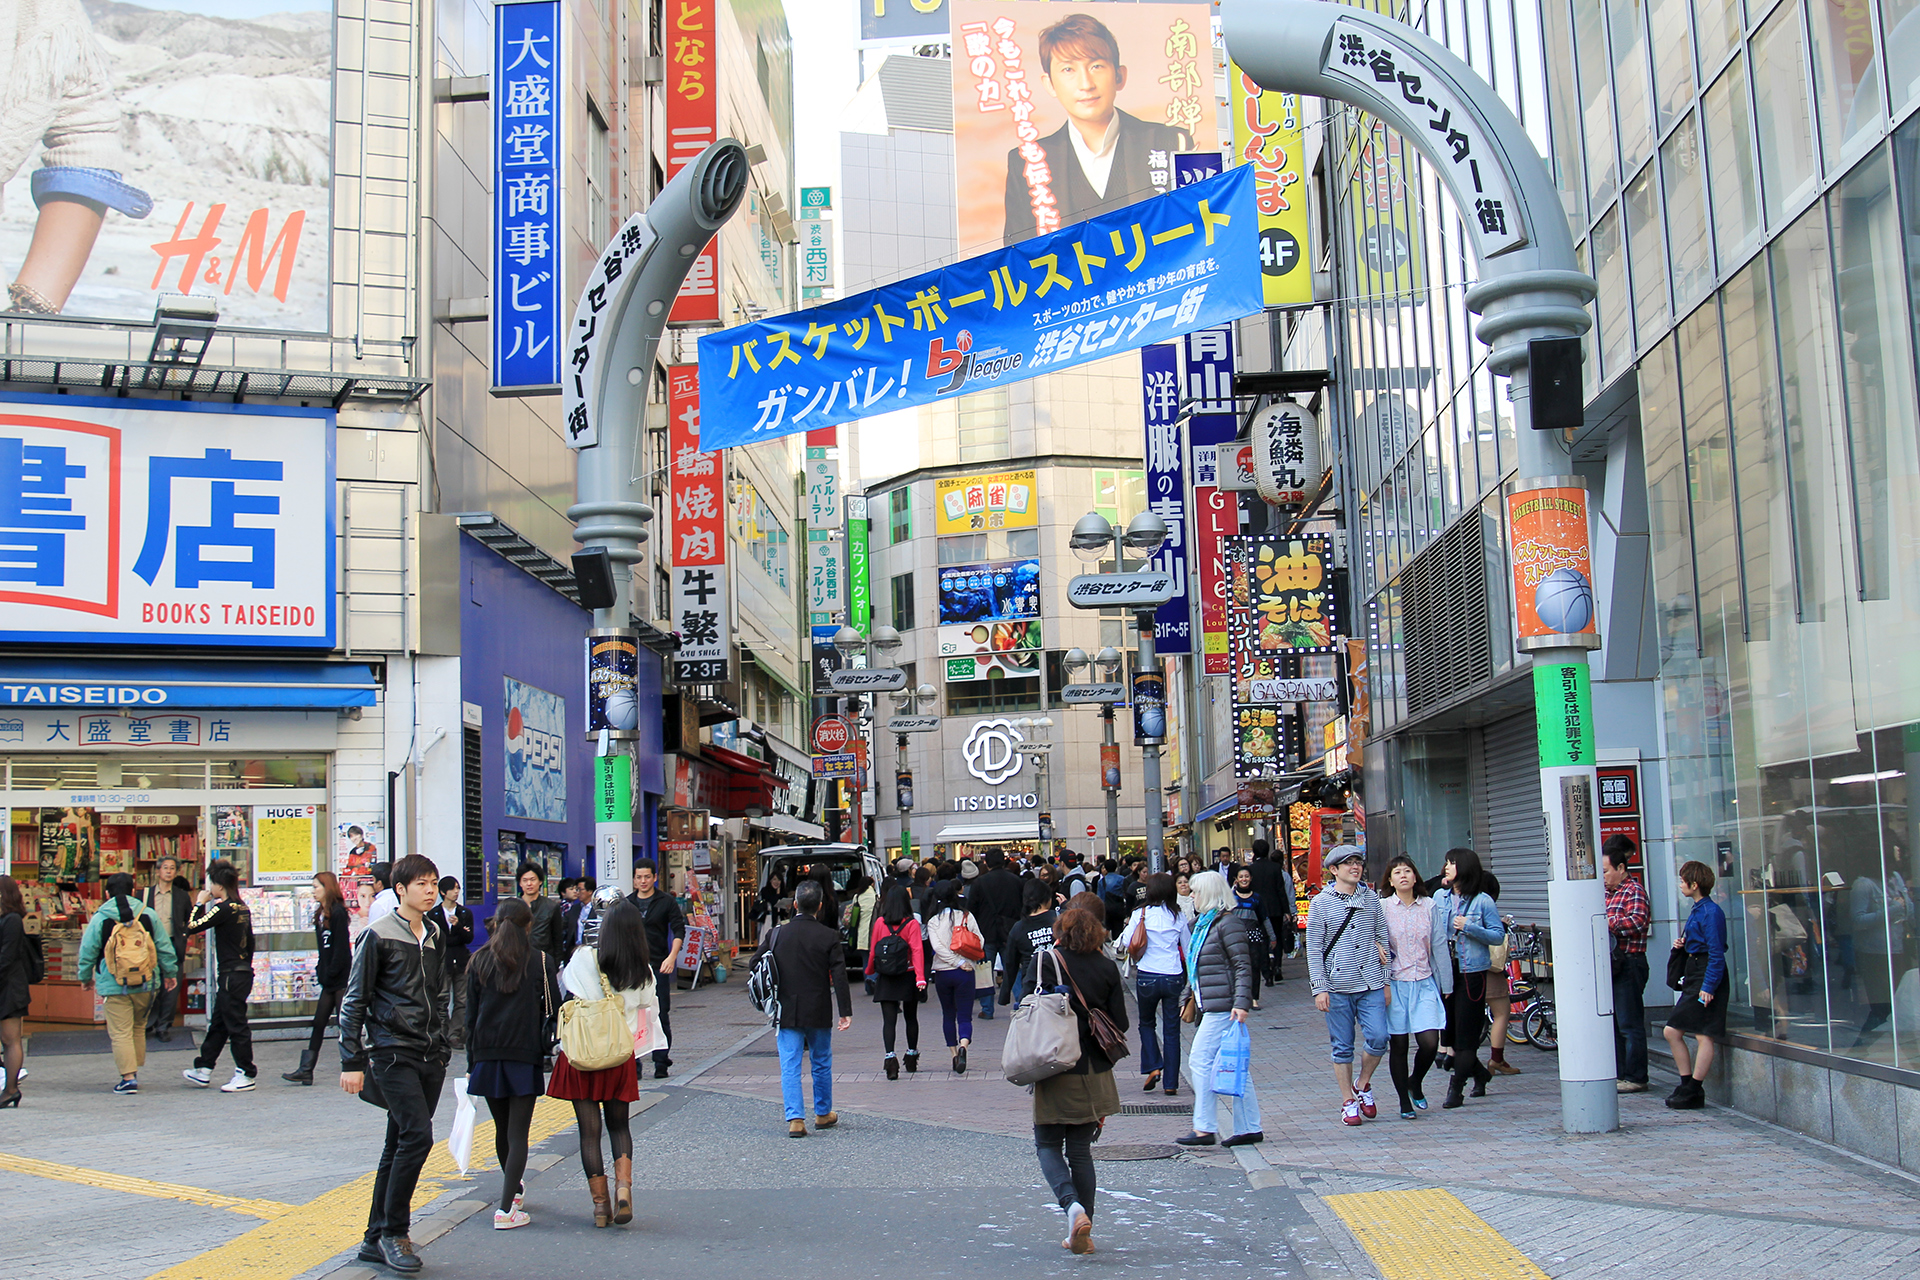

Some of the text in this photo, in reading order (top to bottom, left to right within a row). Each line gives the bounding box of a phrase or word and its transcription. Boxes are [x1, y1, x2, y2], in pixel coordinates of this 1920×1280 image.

[1282, 92, 1296, 129] バーグ
[1339, 34, 1507, 236] 渋谷センター街
[505, 28, 552, 361] 大盛堂商事ビル
[807, 210, 814, 219] 5
[151, 201, 306, 303] H&M
[806, 224, 828, 282] 渋谷西村
[1259, 236, 1294, 267] 4F
[728, 199, 1231, 379] バスケットボールストリート
[1033, 258, 1220, 326] スポーツの力で、健やかな青少年の育成を。
[568, 225, 642, 441] 渋谷センター街
[1028, 284, 1209, 369] 渋谷センター街
[967, 352, 1022, 380] league
[673, 373, 698, 394] 元
[752, 359, 911, 432] ガンバレ！
[812, 449, 819, 457] 2
[1267, 412, 1305, 490] 海鱗丸
[824, 475, 835, 517] フルーツ
[967, 485, 1005, 508] 麻雀
[1146, 371, 1185, 598] 洋服の青山
[0, 438, 284, 589] 書店
[1513, 540, 1588, 564] バスケットボール
[826, 557, 837, 599] 渋谷西村
[1256, 540, 1322, 595] 油
[1525, 559, 1577, 587] ストリート
[813, 566, 824, 606] フルーツ
[1023, 583, 1038, 593] 4F
[1074, 579, 1169, 596] 渋谷センター街
[142, 602, 316, 627] BOOKS TAISEIDO
[681, 569, 719, 646] 牛繁
[815, 614, 825, 623] B1
[1257, 591, 1326, 624] そば
[680, 648, 721, 658] GYU SHIGE
[941, 643, 957, 654] 3F
[1233, 612, 1255, 678] ハンバーグ
[680, 664, 722, 679] 2・3F
[834, 673, 901, 685] 渋谷センター街
[3, 685, 167, 705] TAISEIDO
[1065, 687, 1121, 697] 渋谷センター街
[889, 718, 938, 728] 渋谷センター街
[1560, 667, 1583, 762] 客引きは犯罪です
[46, 719, 231, 742] 大盛堂書店
[819, 729, 845, 742] 消火栓
[522, 727, 563, 773] PEPSI
[825, 760, 854, 772] セキネ
[97, 794, 150, 803] 10:30～21:00
[604, 758, 615, 820] 客引きは犯罪です
[1602, 780, 1626, 792] 高価
[1603, 792, 1628, 805] 買取
[267, 808, 303, 818] HUGE
[954, 793, 1039, 812] ITS'DEMO
[1239, 805, 1264, 813] ライス
[43, 828, 71, 837] ミラノ&
[1572, 785, 1586, 859] 防犯カメラ作動中
[684, 930, 702, 968] 営業中
[1031, 935, 1052, 946] peace
